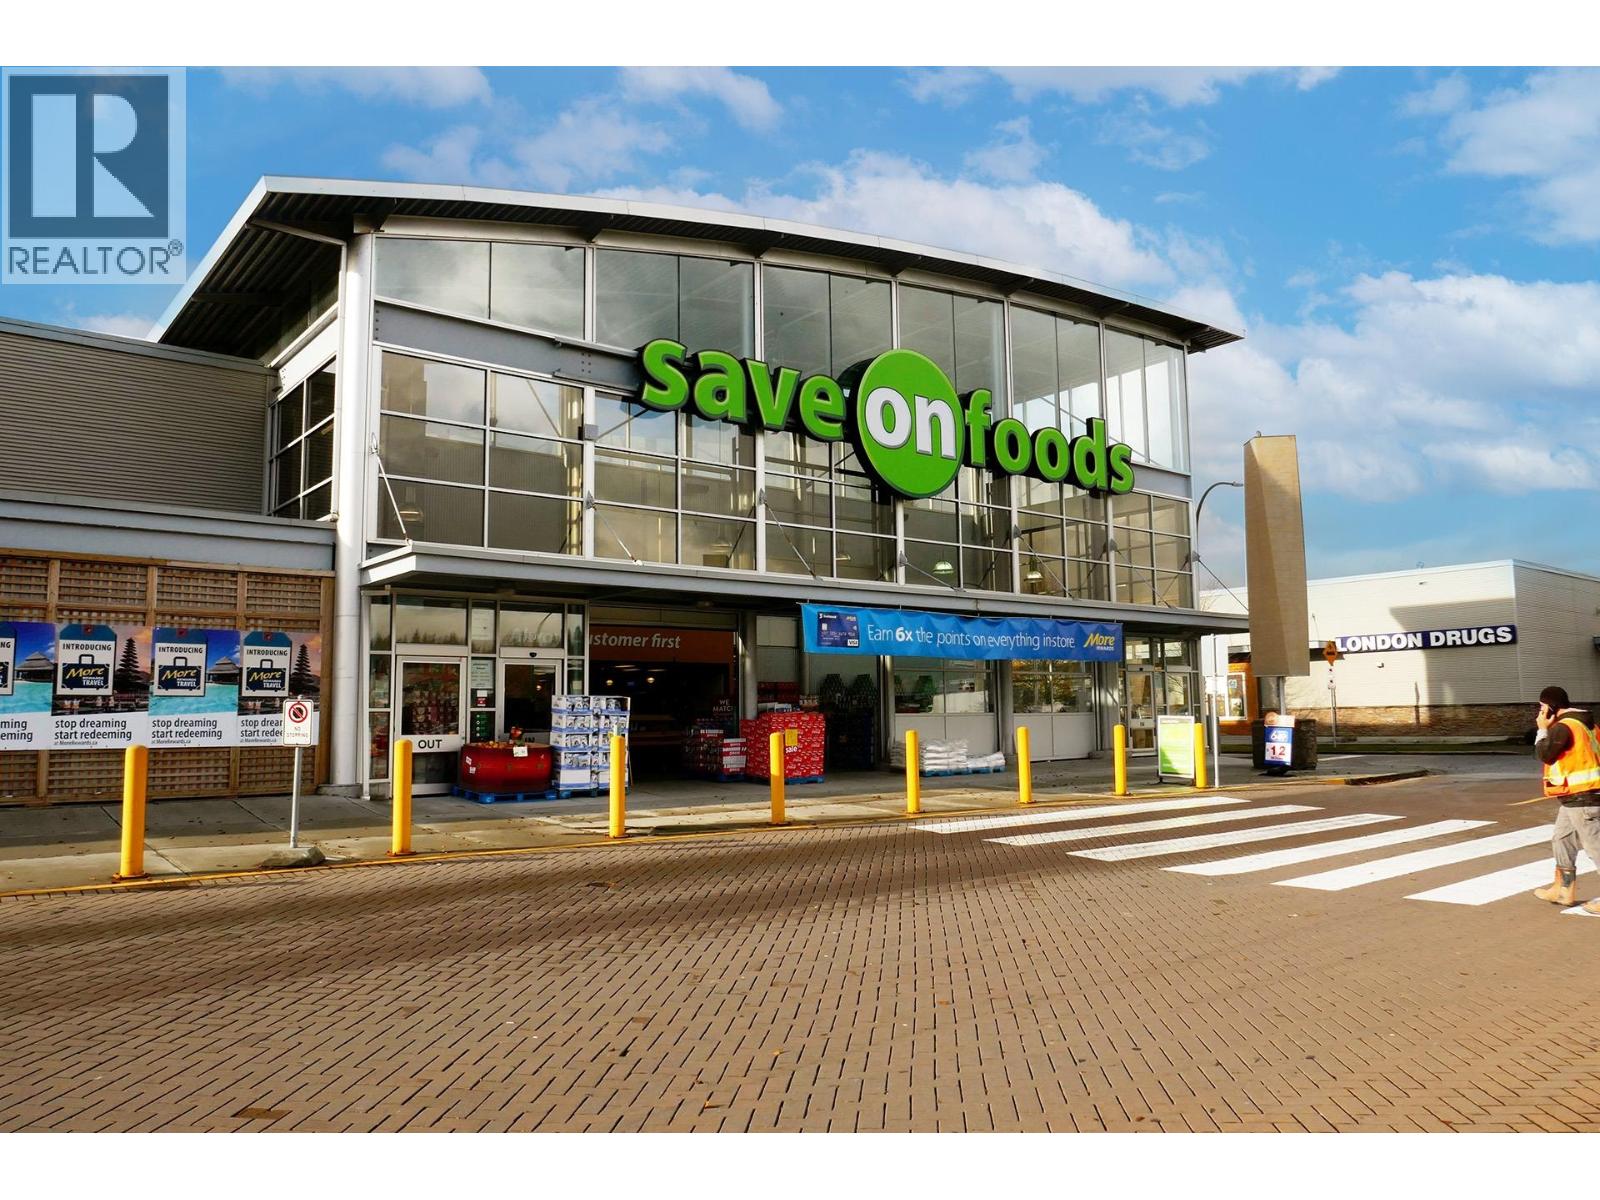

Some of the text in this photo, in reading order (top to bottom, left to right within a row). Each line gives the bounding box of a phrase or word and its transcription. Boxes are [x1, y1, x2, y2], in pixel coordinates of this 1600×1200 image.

[640, 338, 1136, 495] save on foods
[650, 633, 681, 649] first
[867, 624, 894, 642] Earn
[895, 626, 914, 642] 6x
[915, 626, 933, 644] the
[937, 630, 971, 648] points
[972, 634, 986, 647] on
[988, 632, 1041, 651] everything
[1082, 632, 1115, 648] More
[1335, 633, 1424, 652] LONDON
[1430, 626, 1513, 647] DRUGS
[62, 643, 112, 651] INTRODUCING
[158, 646, 203, 654] INTRODUCING
[66, 668, 105, 679] More
[162, 669, 198, 680] More
[249, 671, 282, 682] More
[55, 718, 127, 731] stop dreaming
[152, 718, 217, 730] stop dreaming
[241, 719, 258, 729] stop
[54, 729, 132, 742] start redeeming
[151, 728, 223, 740] start redeeming
[240, 728, 260, 738] start
[418, 739, 443, 749] OUT
[785, 745, 798, 753] sale
